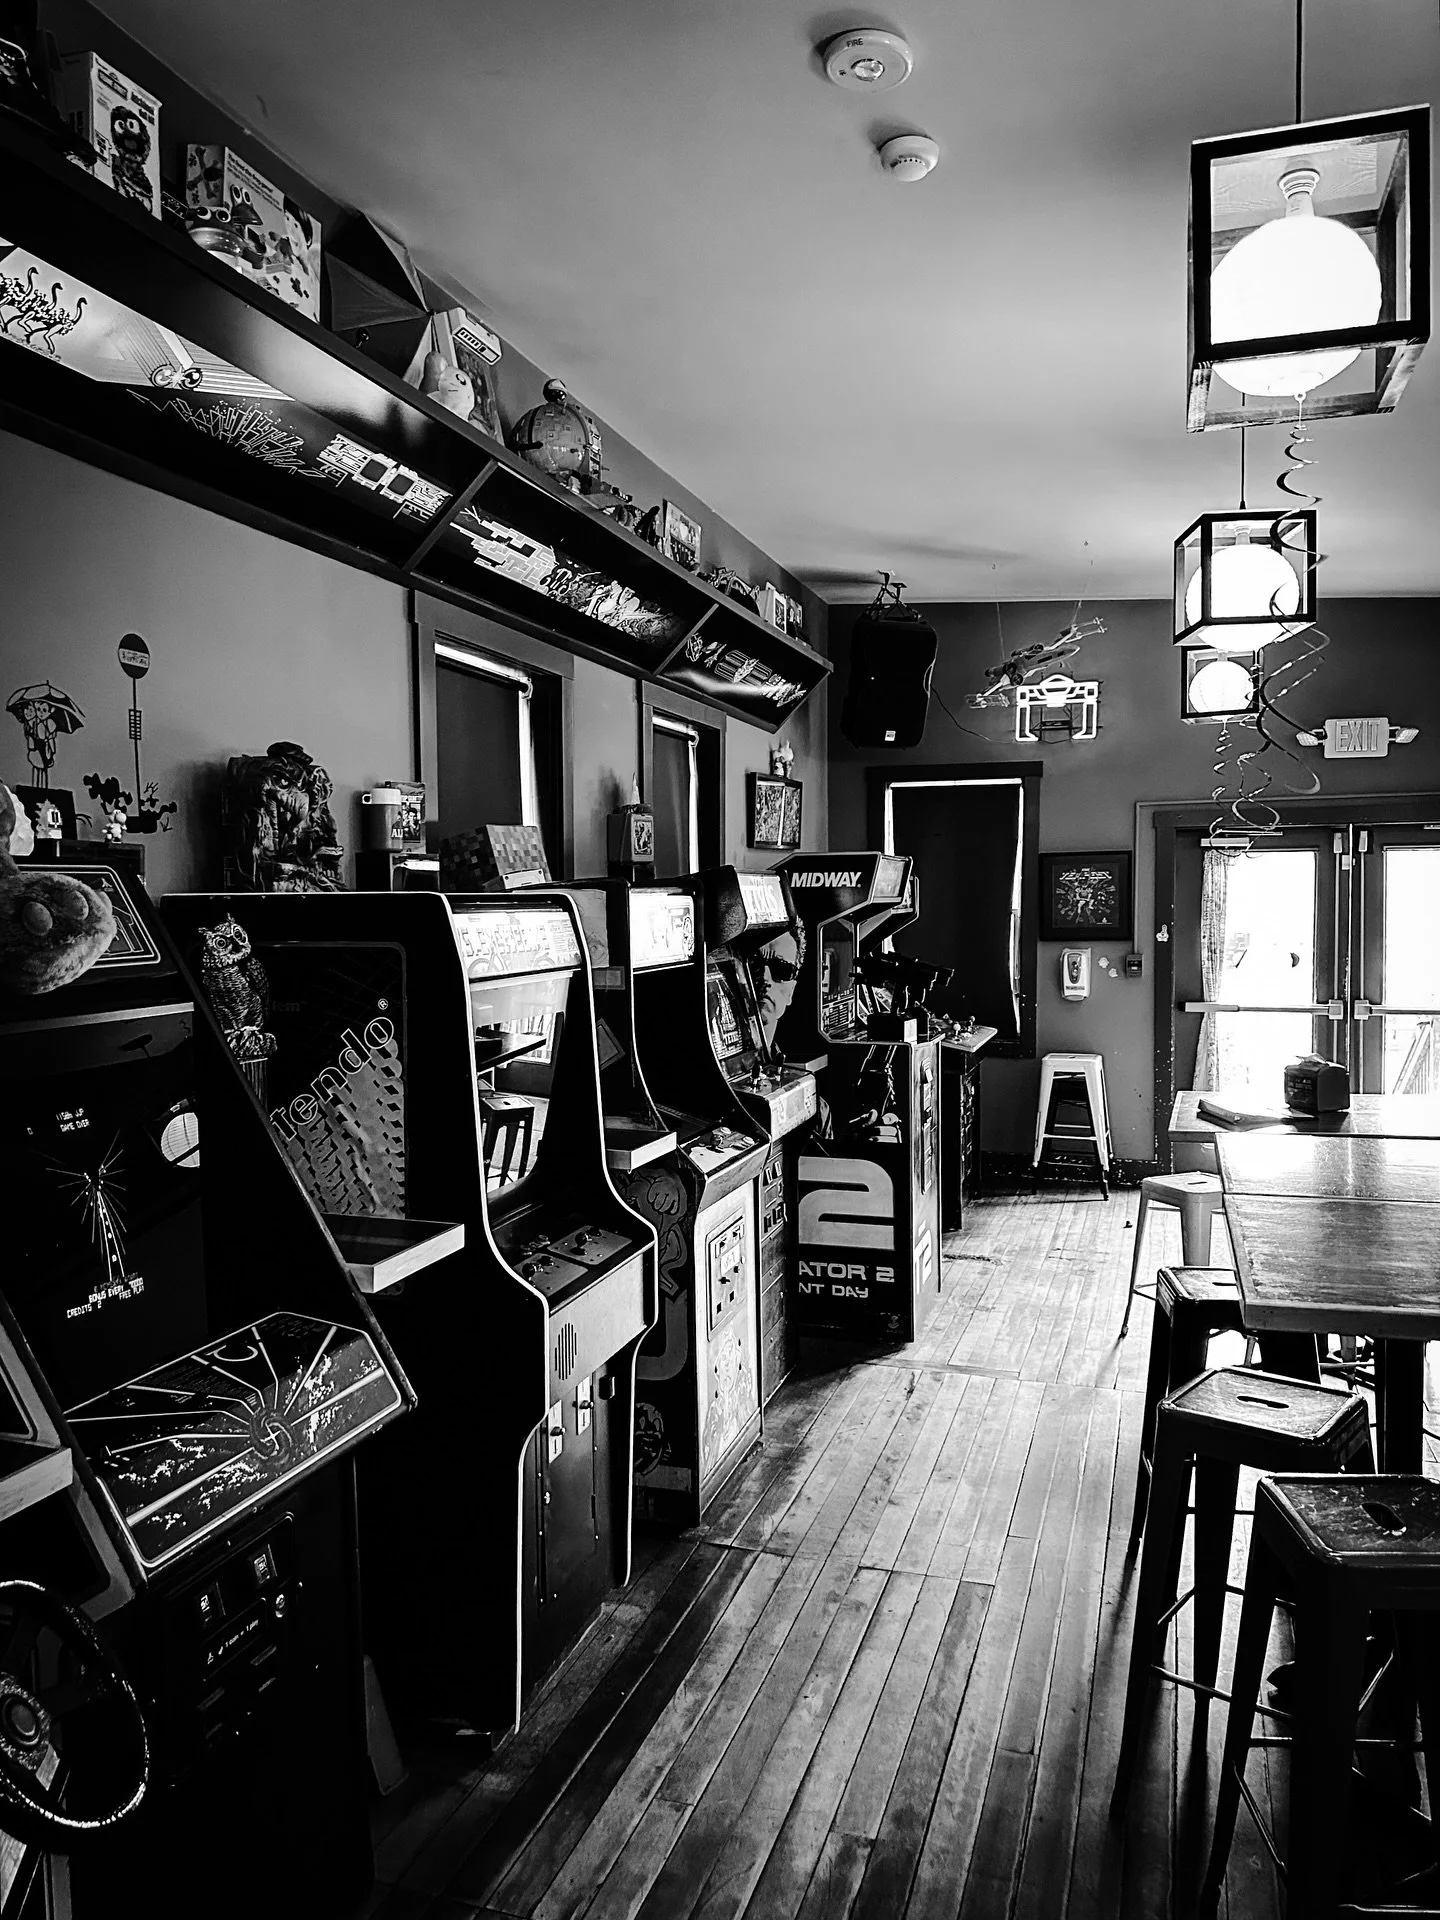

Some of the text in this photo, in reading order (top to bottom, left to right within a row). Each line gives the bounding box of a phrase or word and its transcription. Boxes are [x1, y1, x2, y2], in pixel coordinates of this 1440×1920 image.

[1335, 720, 1381, 752] EXIT
[876, 1266, 895, 1283] 2
[832, 1285, 869, 1298] DAY
[67, 1303, 92, 1319] CREDITS
[119, 1289, 131, 1300] FREE
